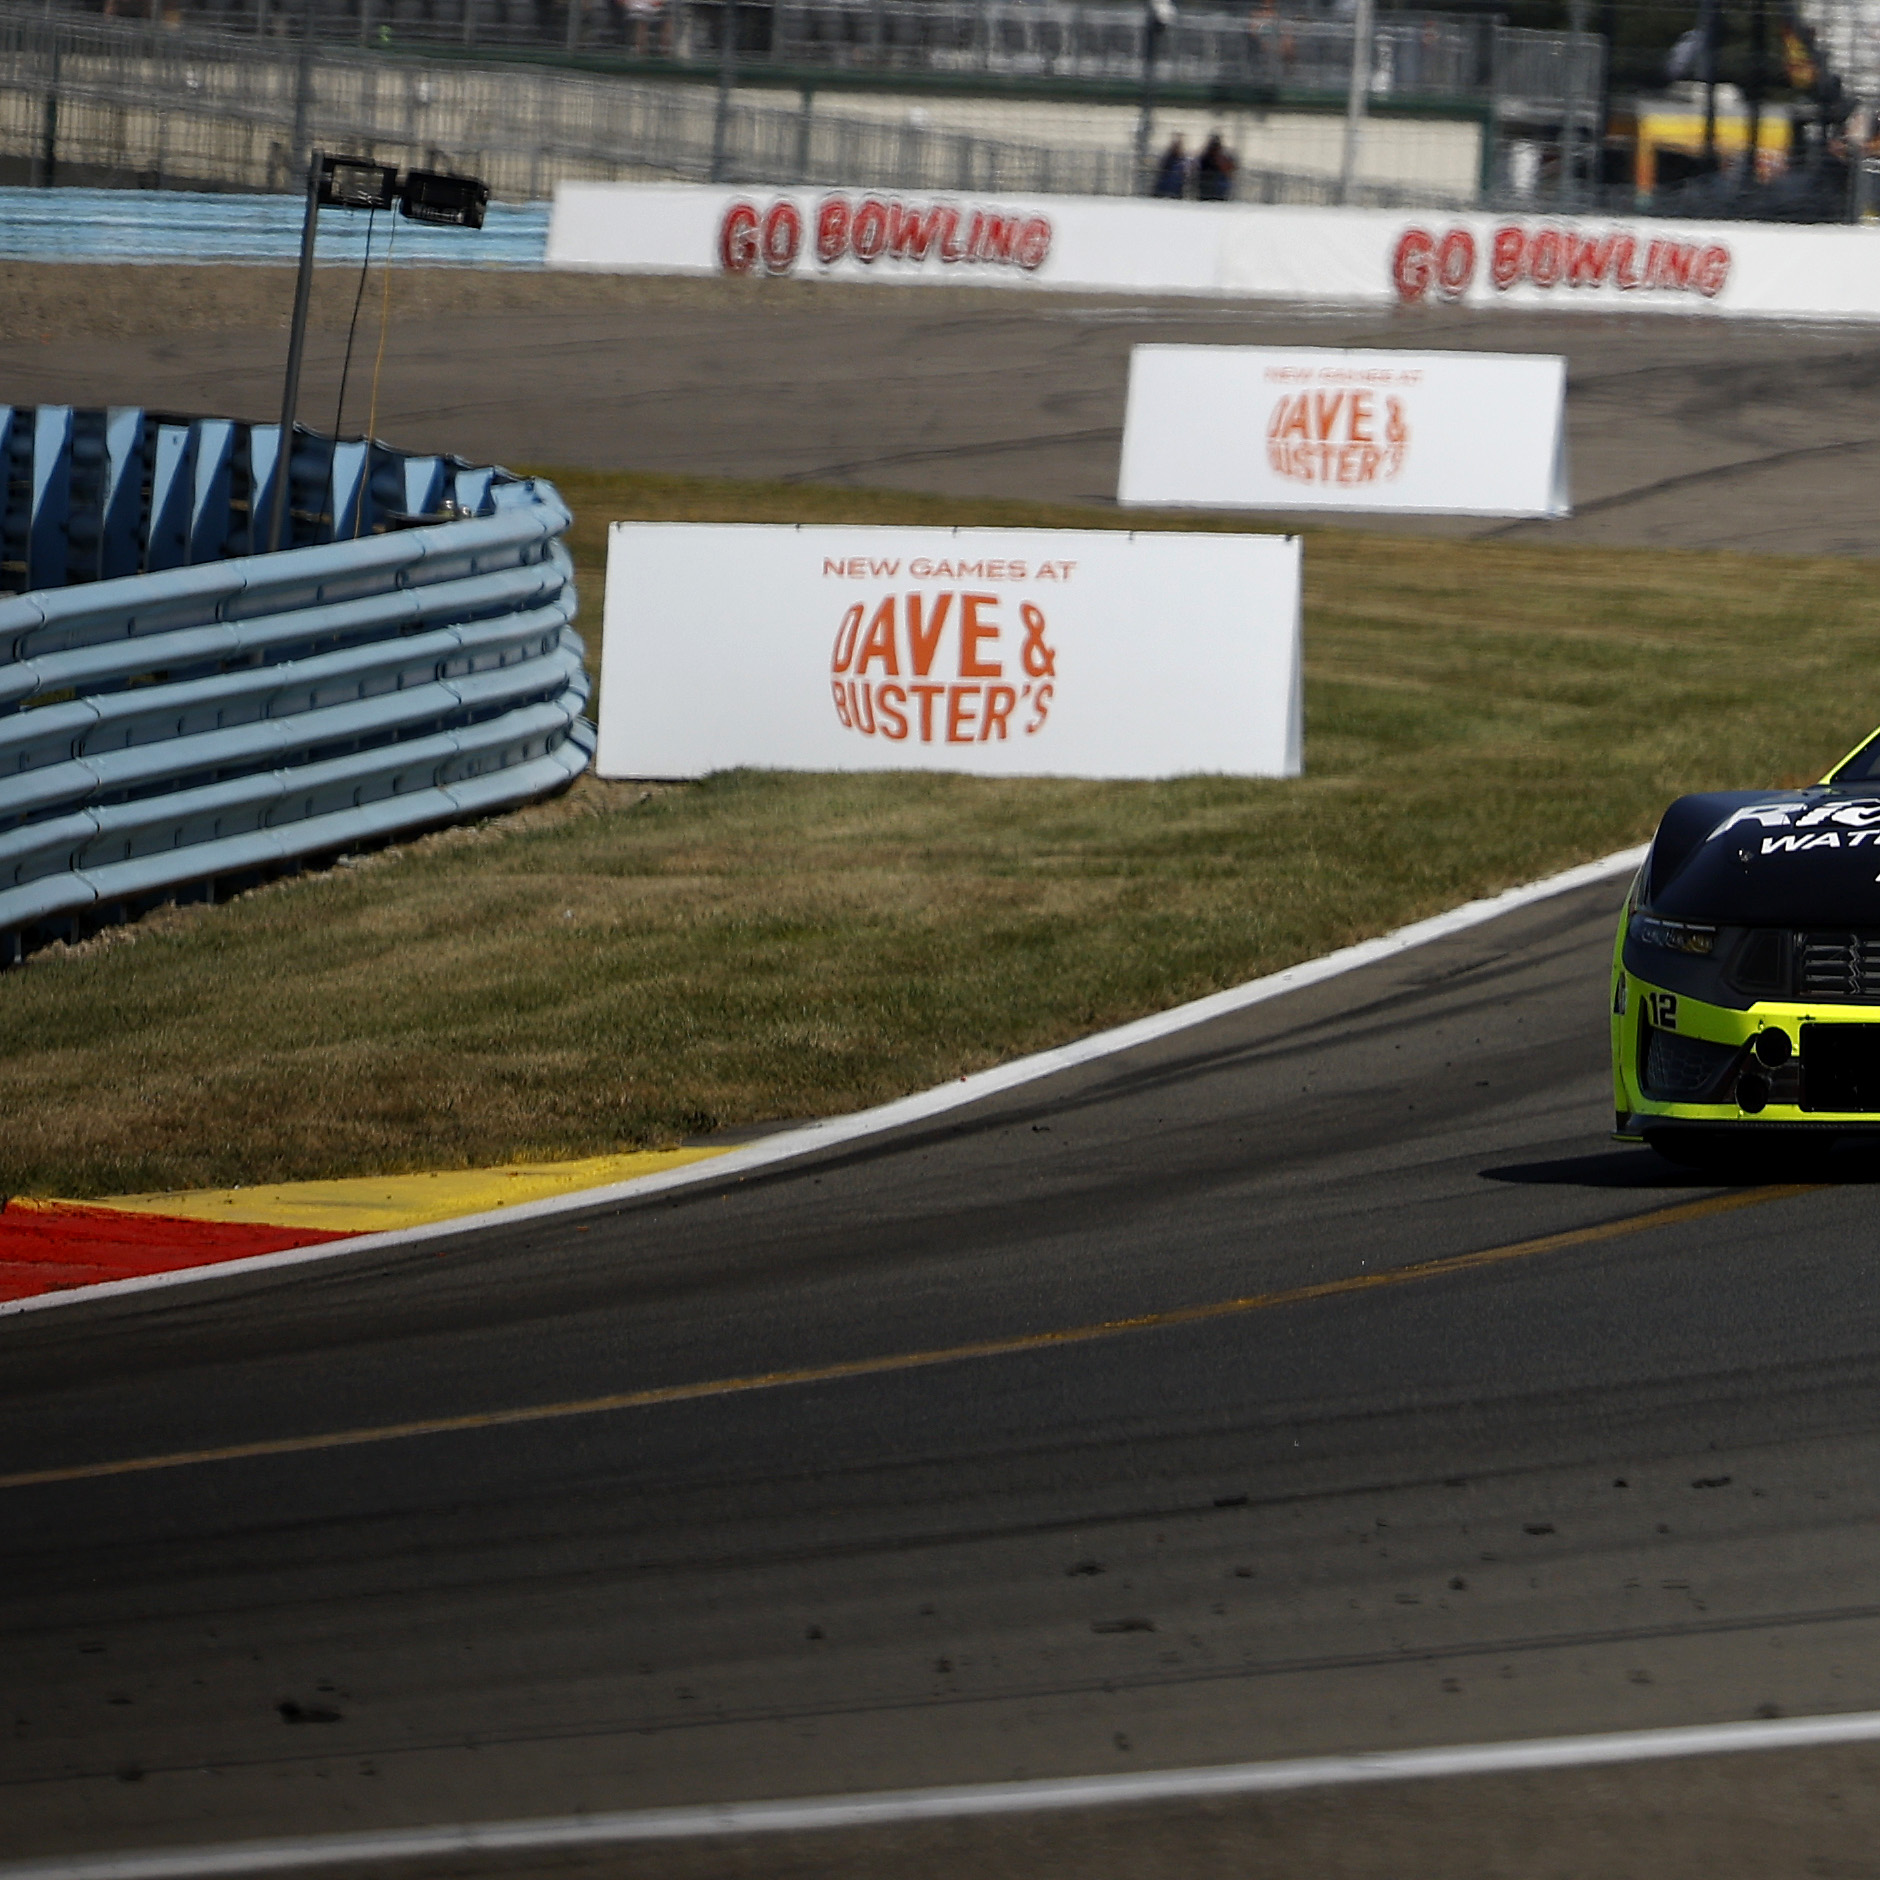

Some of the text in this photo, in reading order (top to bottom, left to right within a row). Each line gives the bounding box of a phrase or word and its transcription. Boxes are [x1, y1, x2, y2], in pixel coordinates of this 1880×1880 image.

[722, 199, 1051, 274] GO BOWLING
[1394, 228, 1732, 302] GO BOWLING
[823, 557, 1077, 582] NEW GAMES AT
[831, 593, 1055, 677] DAVE &
[832, 680, 1053, 742] BUSTER'S
[1648, 991, 1678, 1031] 12
